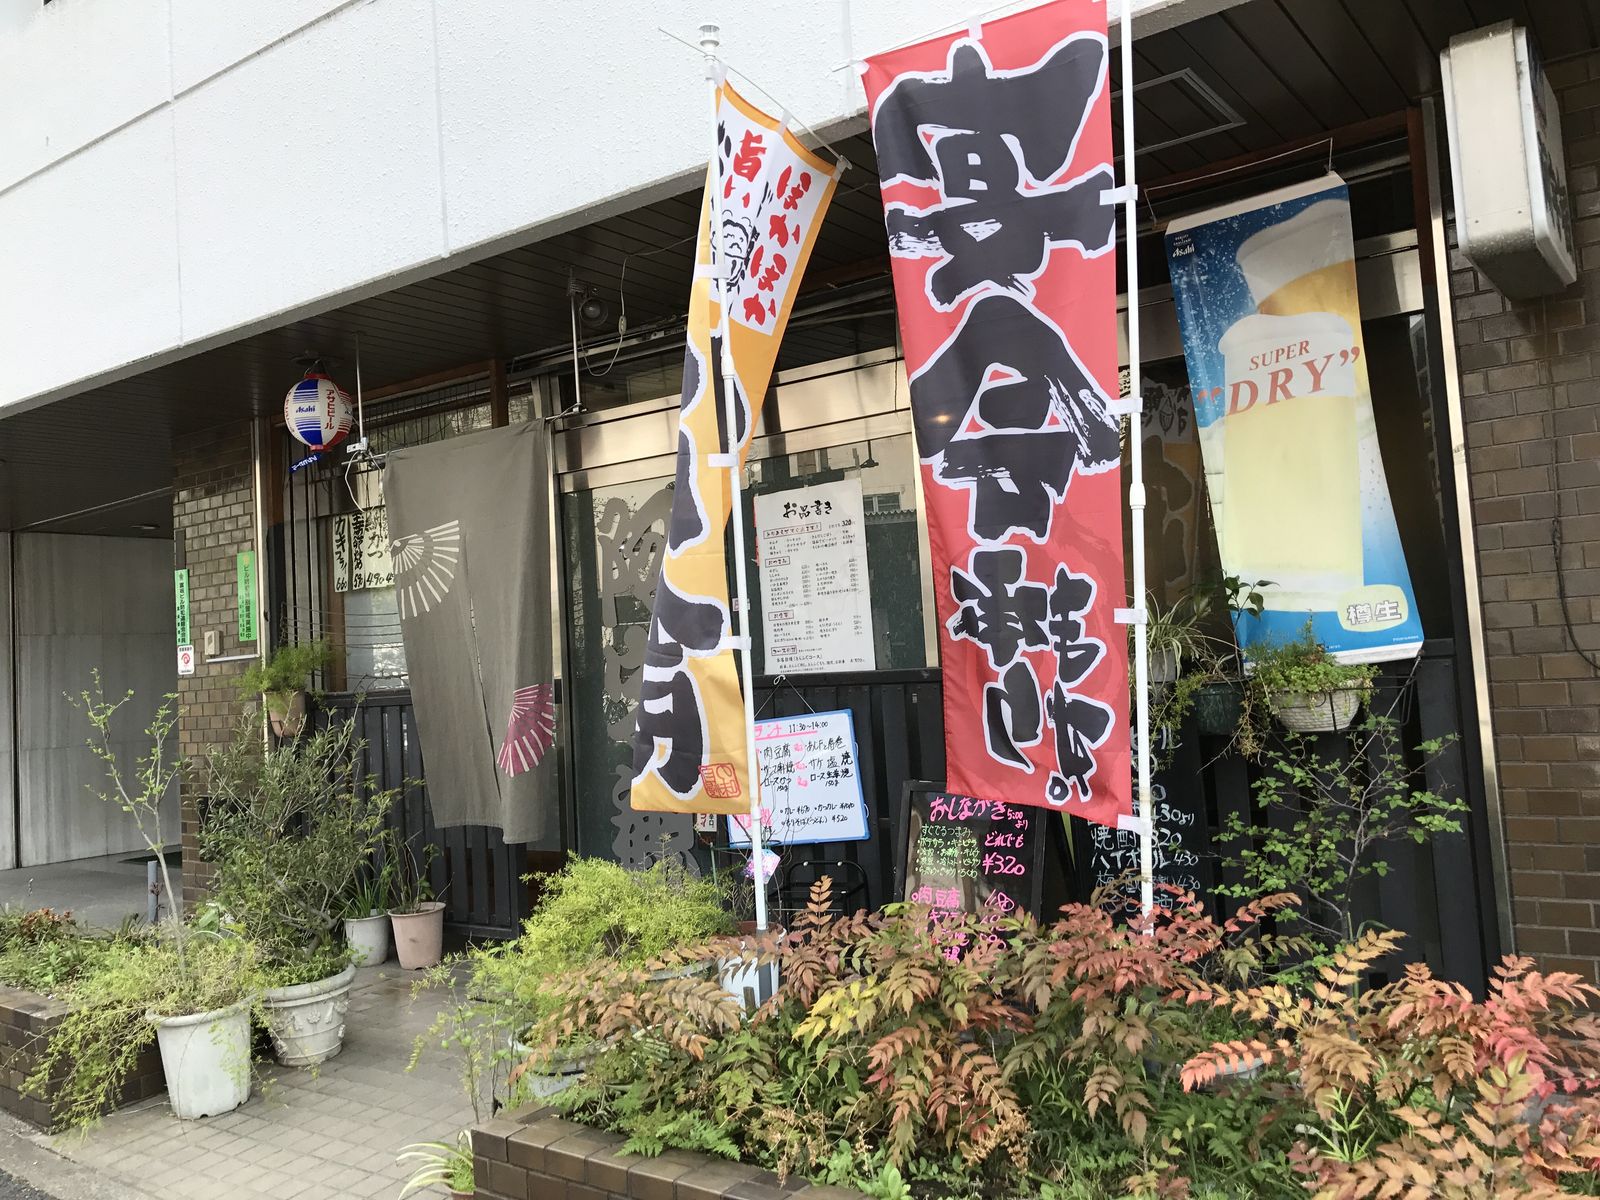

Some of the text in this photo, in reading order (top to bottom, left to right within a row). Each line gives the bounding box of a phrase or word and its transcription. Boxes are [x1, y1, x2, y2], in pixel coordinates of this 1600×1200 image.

[743, 165, 812, 326] ぽかぽか
[1172, 243, 1195, 258] Asahi
[1249, 340, 1310, 371] SUPER
[296, 405, 316, 413] Asahi
[325, 389, 336, 430] アサヒビール
[783, 500, 833, 519] お品書き
[335, 517, 348, 574] カキフライ
[1347, 600, 1402, 625] 樽生
[929, 796, 1007, 822] おしながき
[984, 831, 1024, 848] どれでも
[982, 853, 1026, 876] ¥320
